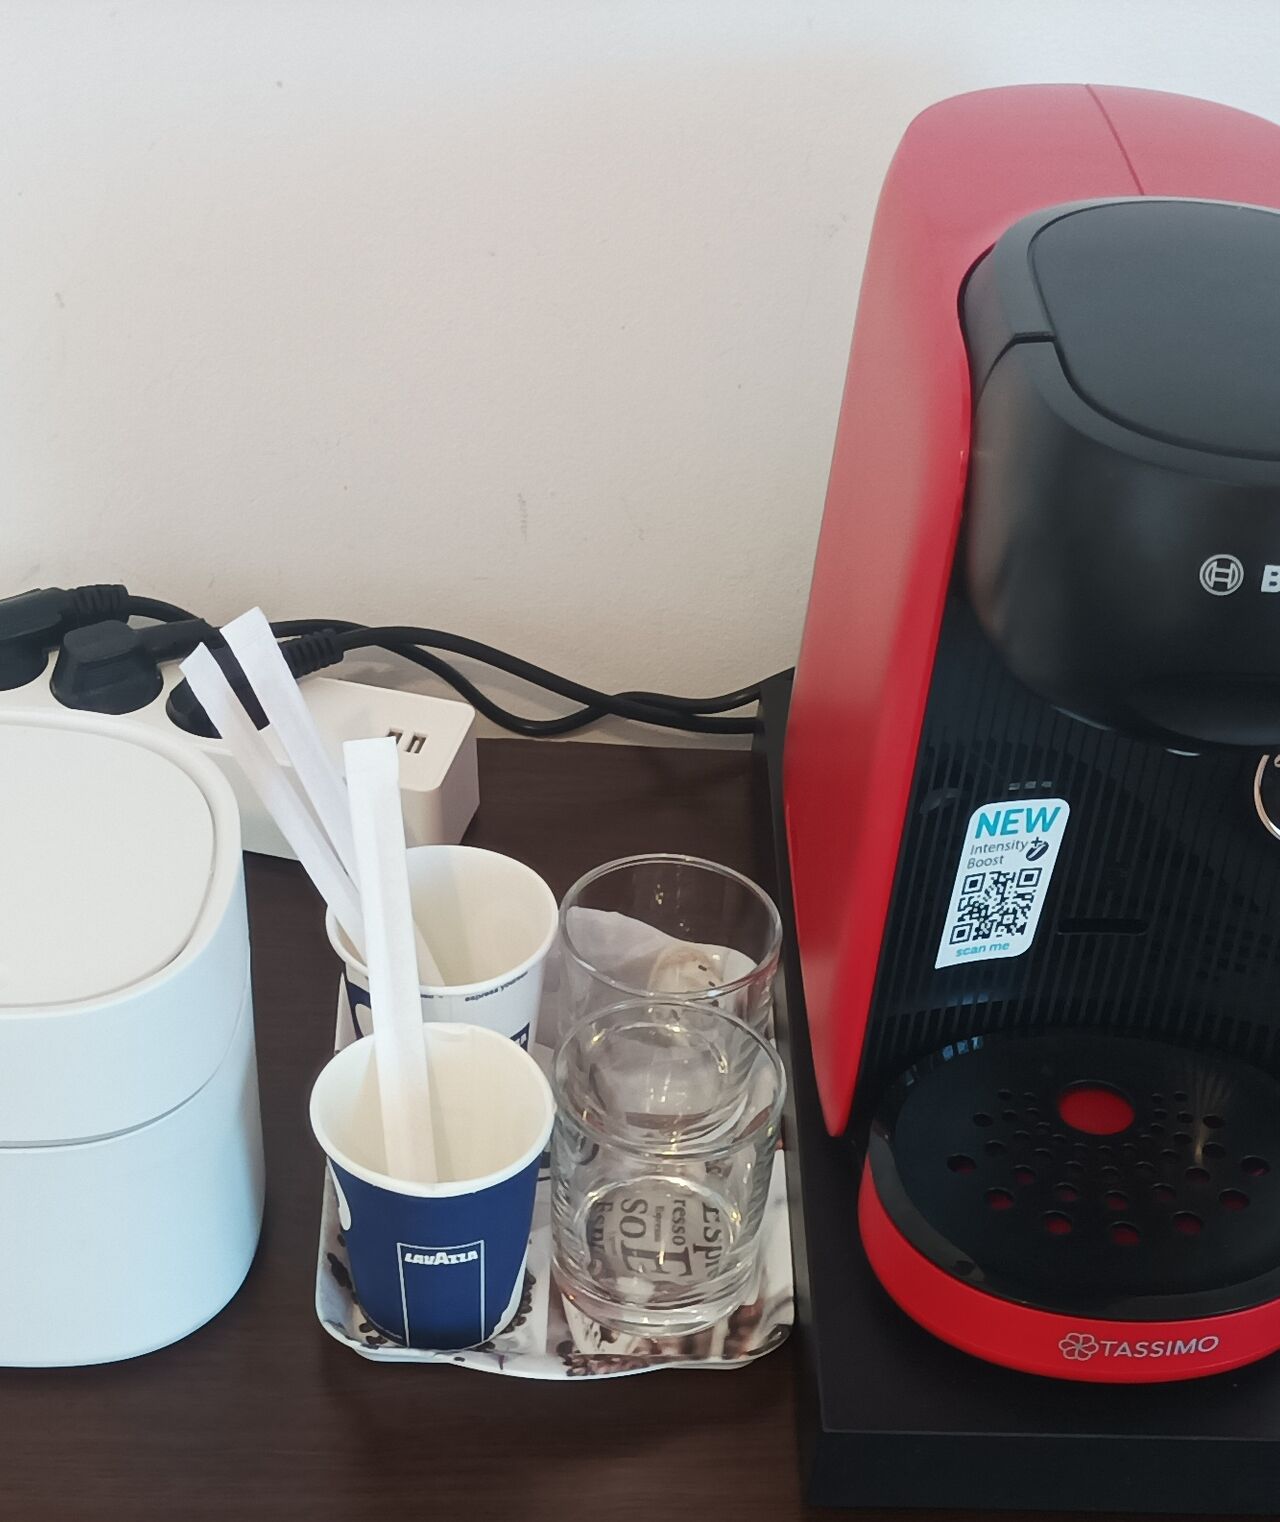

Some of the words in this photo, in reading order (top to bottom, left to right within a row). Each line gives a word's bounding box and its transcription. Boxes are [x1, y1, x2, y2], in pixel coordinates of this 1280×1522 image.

[975, 807, 1061, 839] NEW
[970, 839, 1029, 855] Intensity
[967, 855, 1004, 869] Boost
[956, 945, 986, 957] scan
[989, 942, 1010, 953] me
[404, 1250, 479, 1265] LAVAZZA
[1100, 1335, 1219, 1358] TASSIMO
